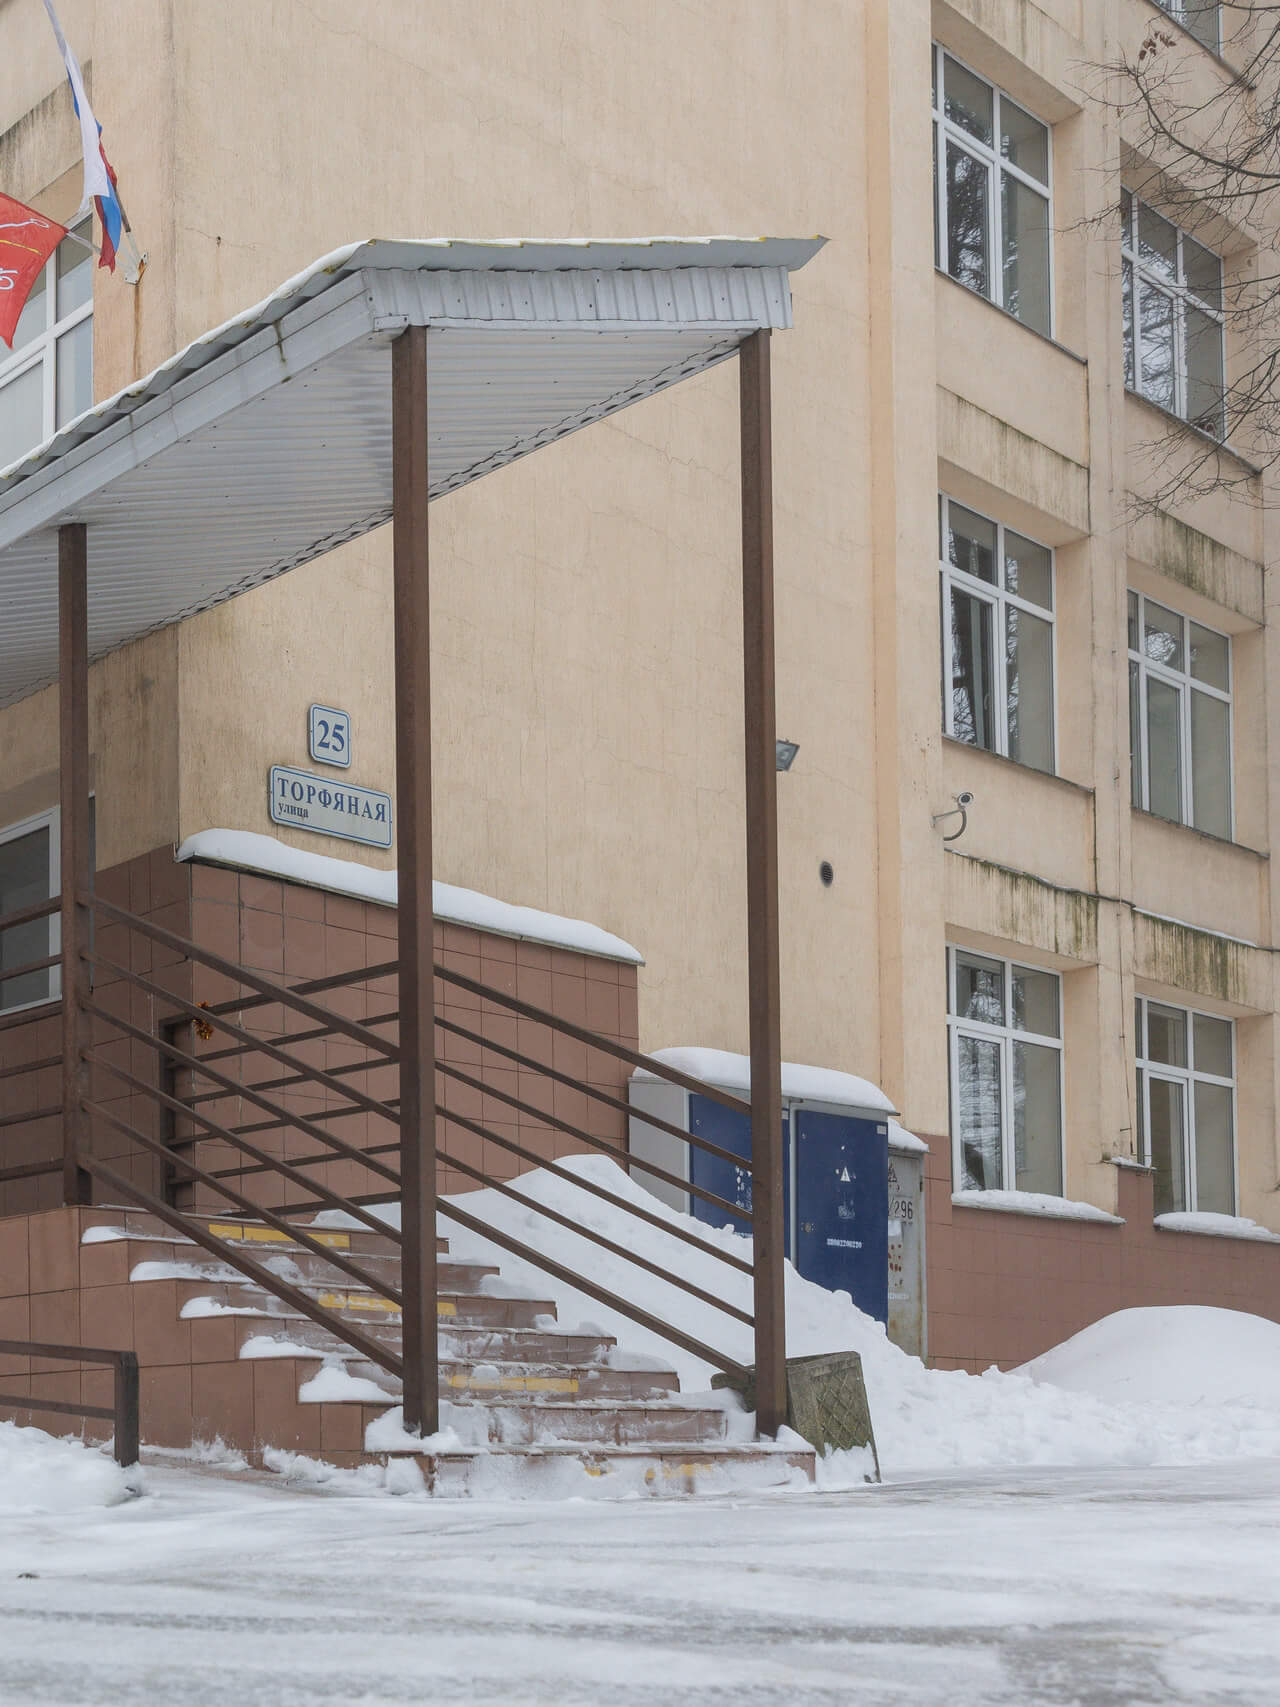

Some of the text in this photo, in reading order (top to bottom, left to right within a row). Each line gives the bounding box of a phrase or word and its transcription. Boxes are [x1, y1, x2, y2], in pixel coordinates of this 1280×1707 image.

[318, 720, 345, 752] 25
[277, 778, 386, 822] ТОРФЯНАЯ
[278, 802, 309, 818] улица
